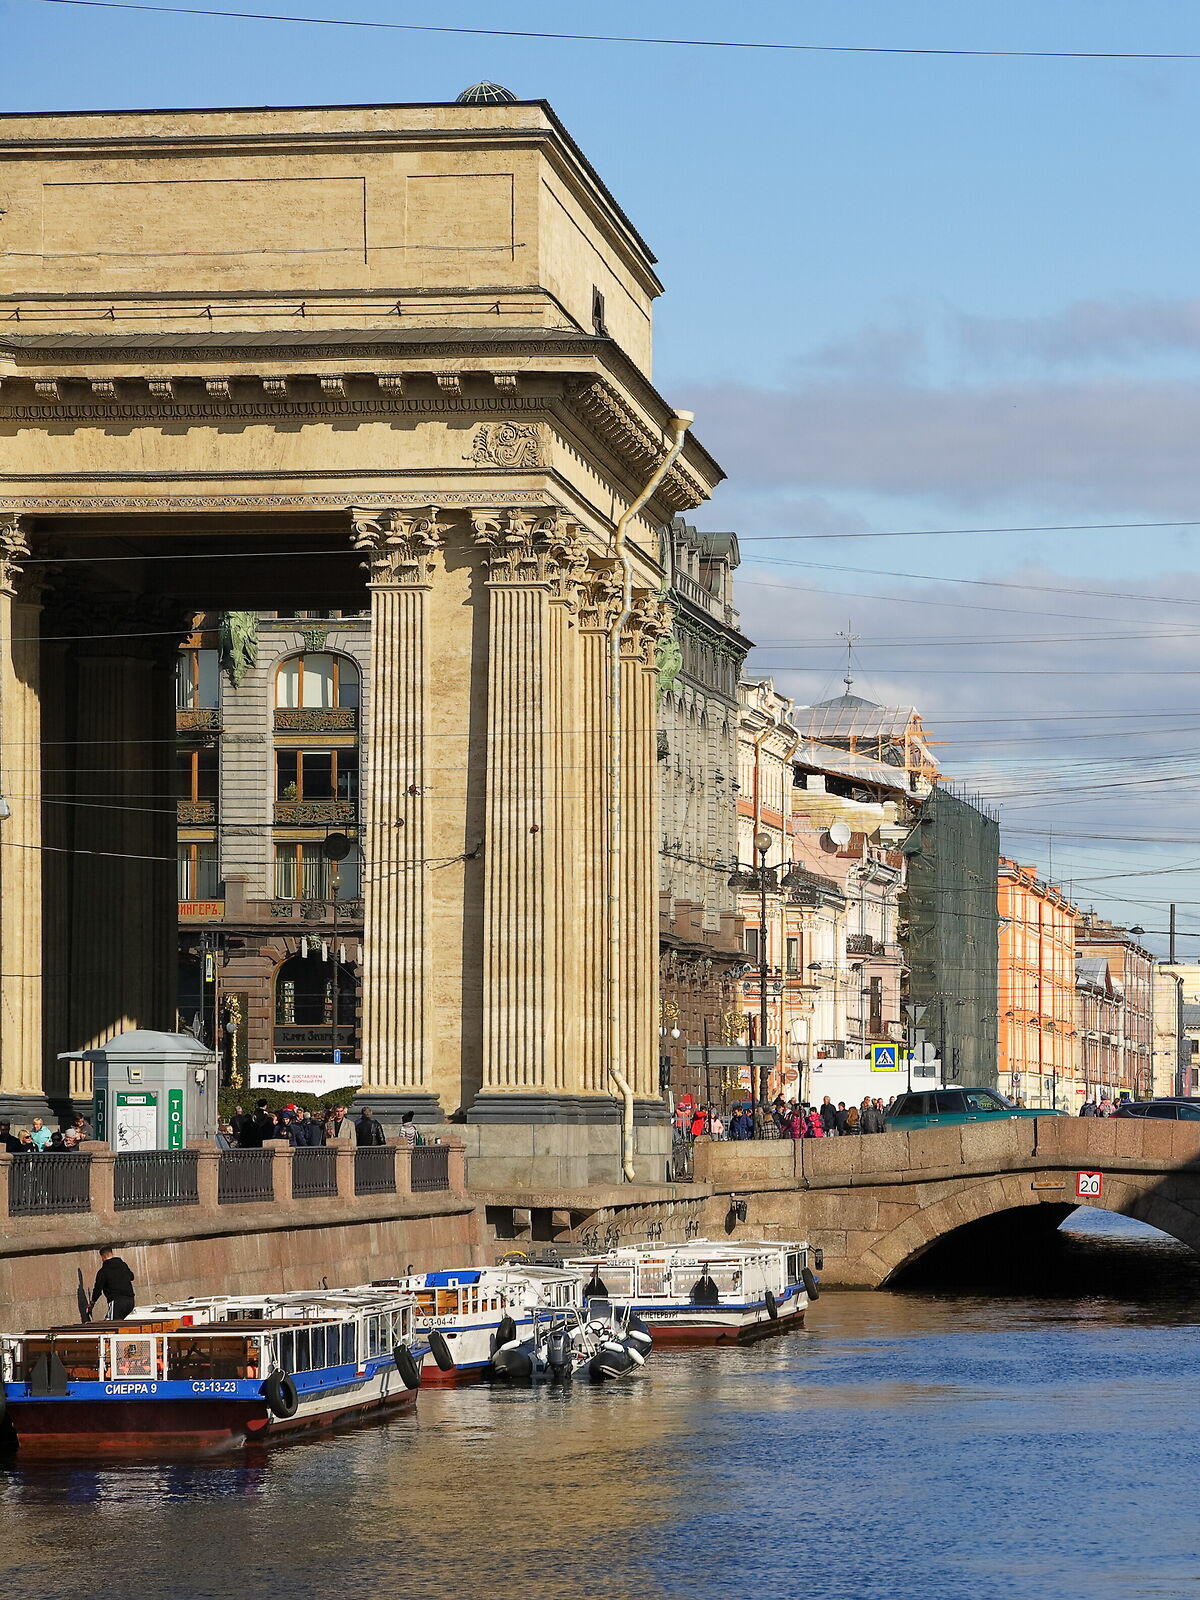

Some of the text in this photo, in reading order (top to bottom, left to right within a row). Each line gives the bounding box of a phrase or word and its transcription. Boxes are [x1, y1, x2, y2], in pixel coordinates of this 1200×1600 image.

[171, 1099, 180, 1151] TOIL
[1080, 1180, 1099, 1194] 2.0
[105, 1383, 157, 1395] СИЕРРА 9
